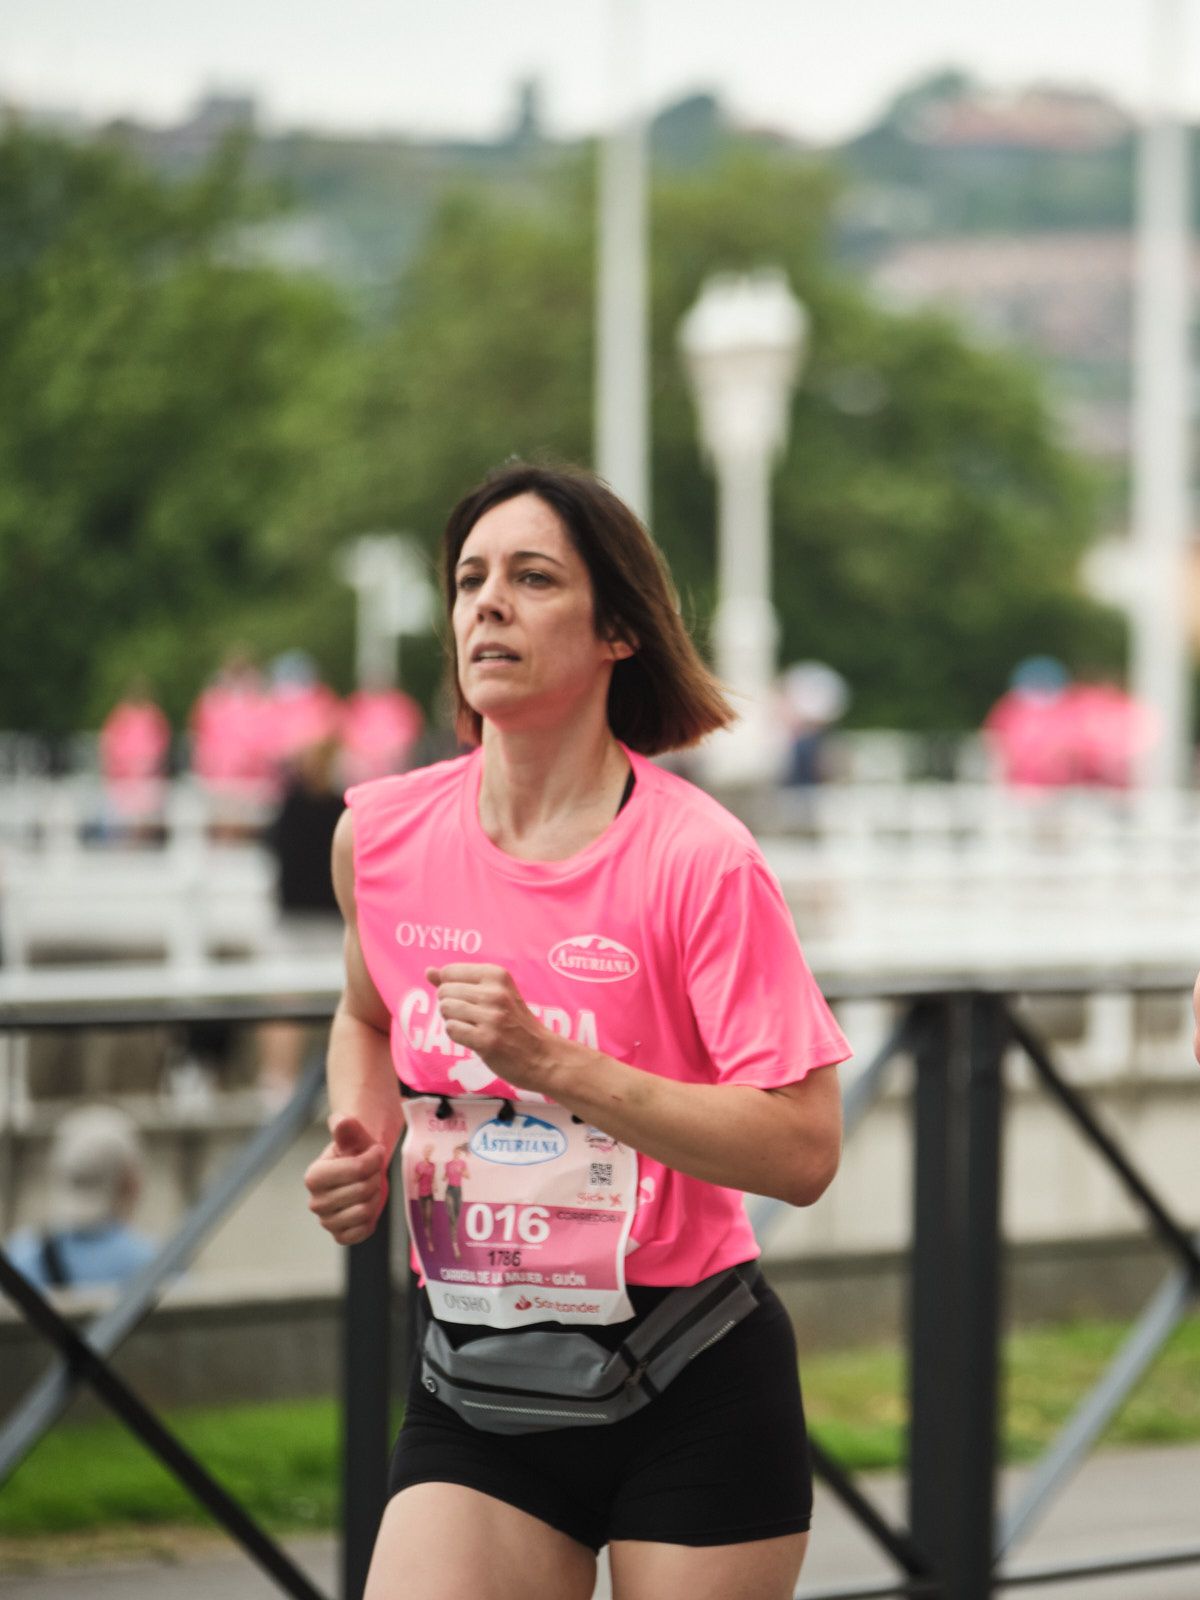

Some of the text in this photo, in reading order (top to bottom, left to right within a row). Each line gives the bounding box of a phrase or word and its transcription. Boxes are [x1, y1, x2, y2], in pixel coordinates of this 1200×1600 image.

[395, 921, 482, 954] OYSHO
[400, 990, 599, 1057] CARA
[465, 1203, 550, 1244] 016
[534, 1297, 600, 1313] Santander
